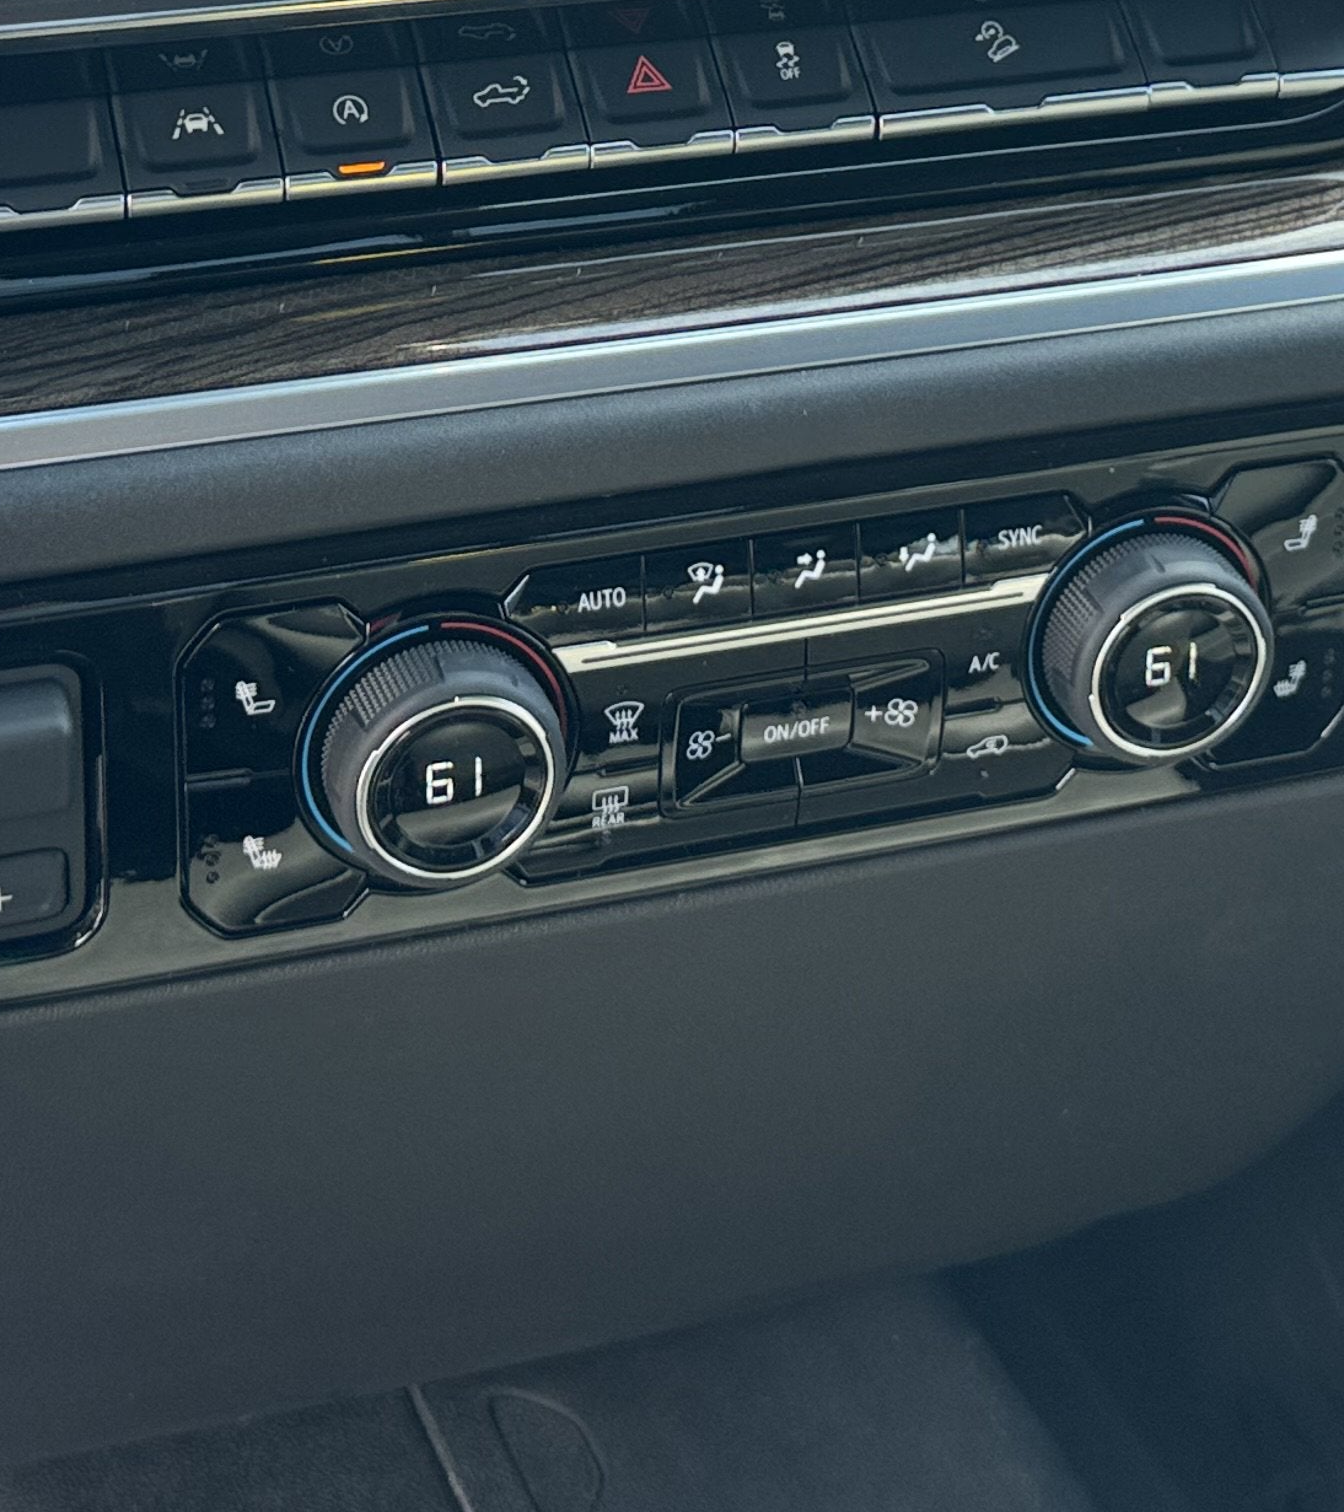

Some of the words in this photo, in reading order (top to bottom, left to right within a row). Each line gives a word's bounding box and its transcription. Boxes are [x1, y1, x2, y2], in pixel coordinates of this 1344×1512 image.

[780, 67, 800, 80] OFF
[998, 524, 1042, 550] SYNC
[578, 587, 626, 613] AUTO
[968, 652, 1000, 673] A/C
[1146, 642, 1197, 686] 61
[609, 728, 638, 744] MAX
[764, 716, 830, 743] ON/OFF
[426, 756, 483, 804] 61
[592, 812, 624, 828] REAR
